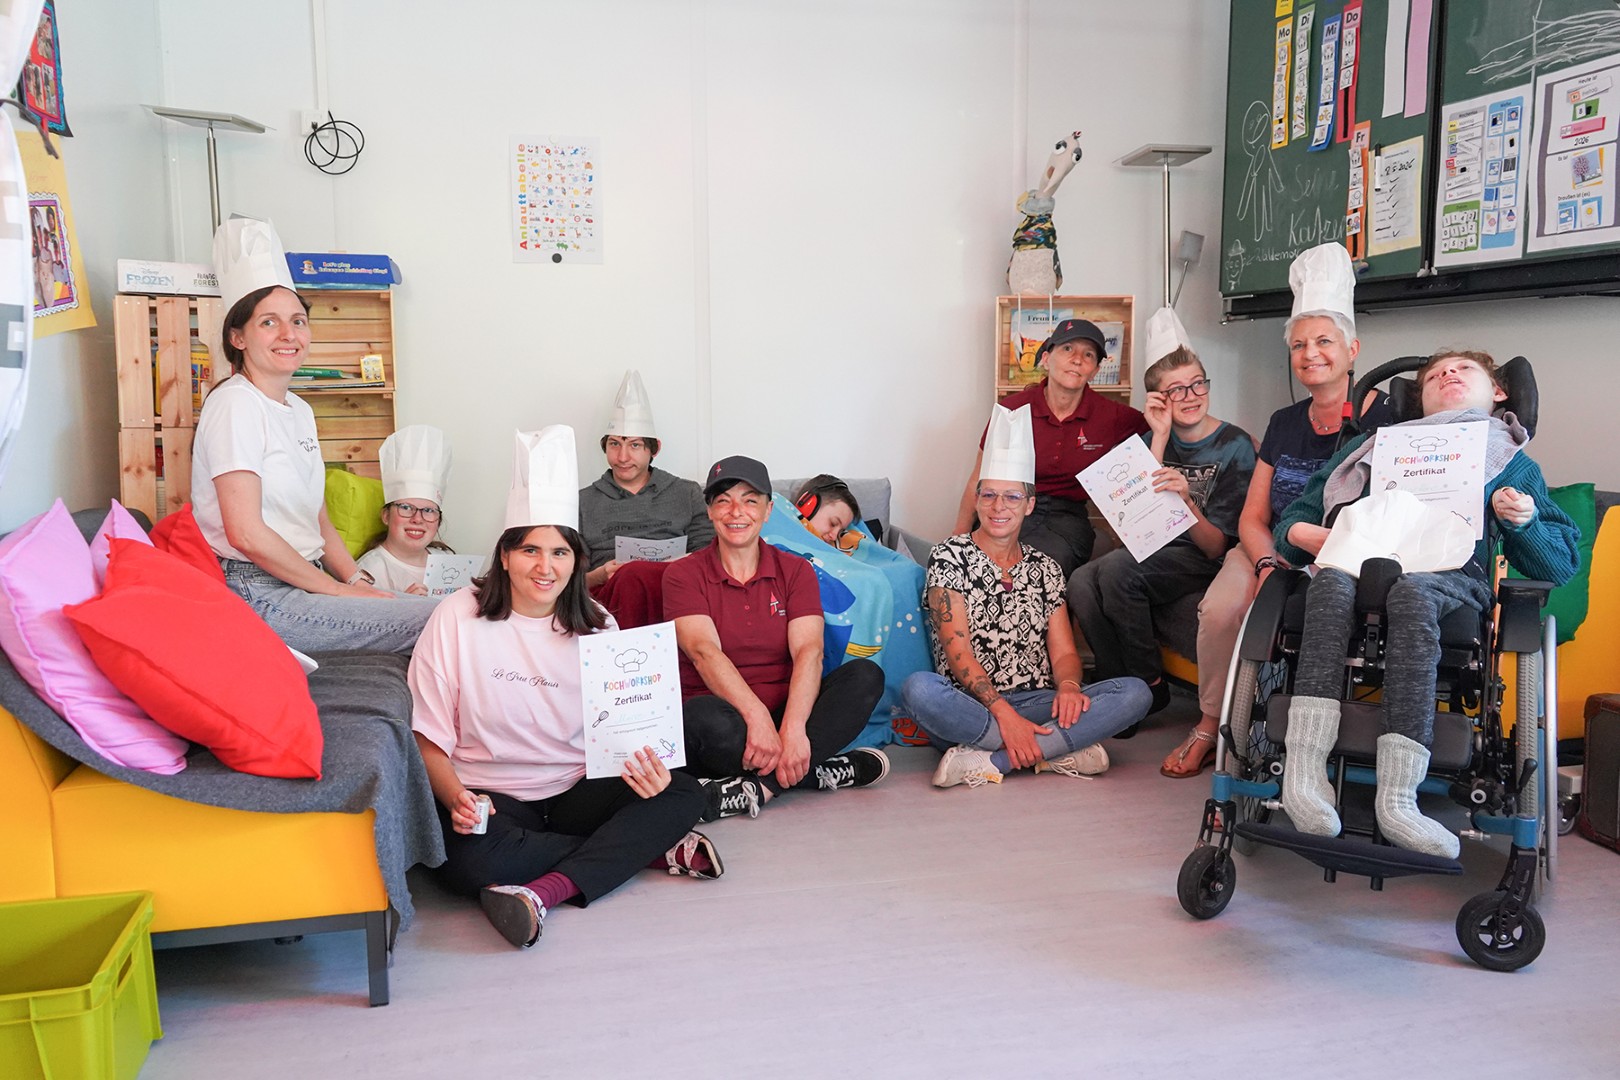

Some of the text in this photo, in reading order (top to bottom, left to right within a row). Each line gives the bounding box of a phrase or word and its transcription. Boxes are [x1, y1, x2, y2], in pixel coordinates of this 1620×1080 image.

[1301, 13, 1310, 27] Di
[1346, 12, 1358, 24] Do
[1278, 27, 1290, 39] Mo
[1326, 23, 1337, 37] Mi
[1356, 131, 1365, 143] Fr
[1574, 136, 1590, 146] 2026
[517, 144, 528, 250] Anlauttabelle
[126, 273, 174, 287] FROZEN
[1394, 453, 1461, 466] KOCHWORKSHOP
[1403, 467, 1446, 478] Zertifikat
[1108, 470, 1149, 501] KOCHWORKSHOP
[1121, 485, 1149, 506] Zertifikat
[491, 668, 504, 680] Le
[529, 676, 559, 688] Plaisir
[604, 673, 662, 693] KOCHWORKSHOP
[614, 692, 652, 706] Zertifikat
